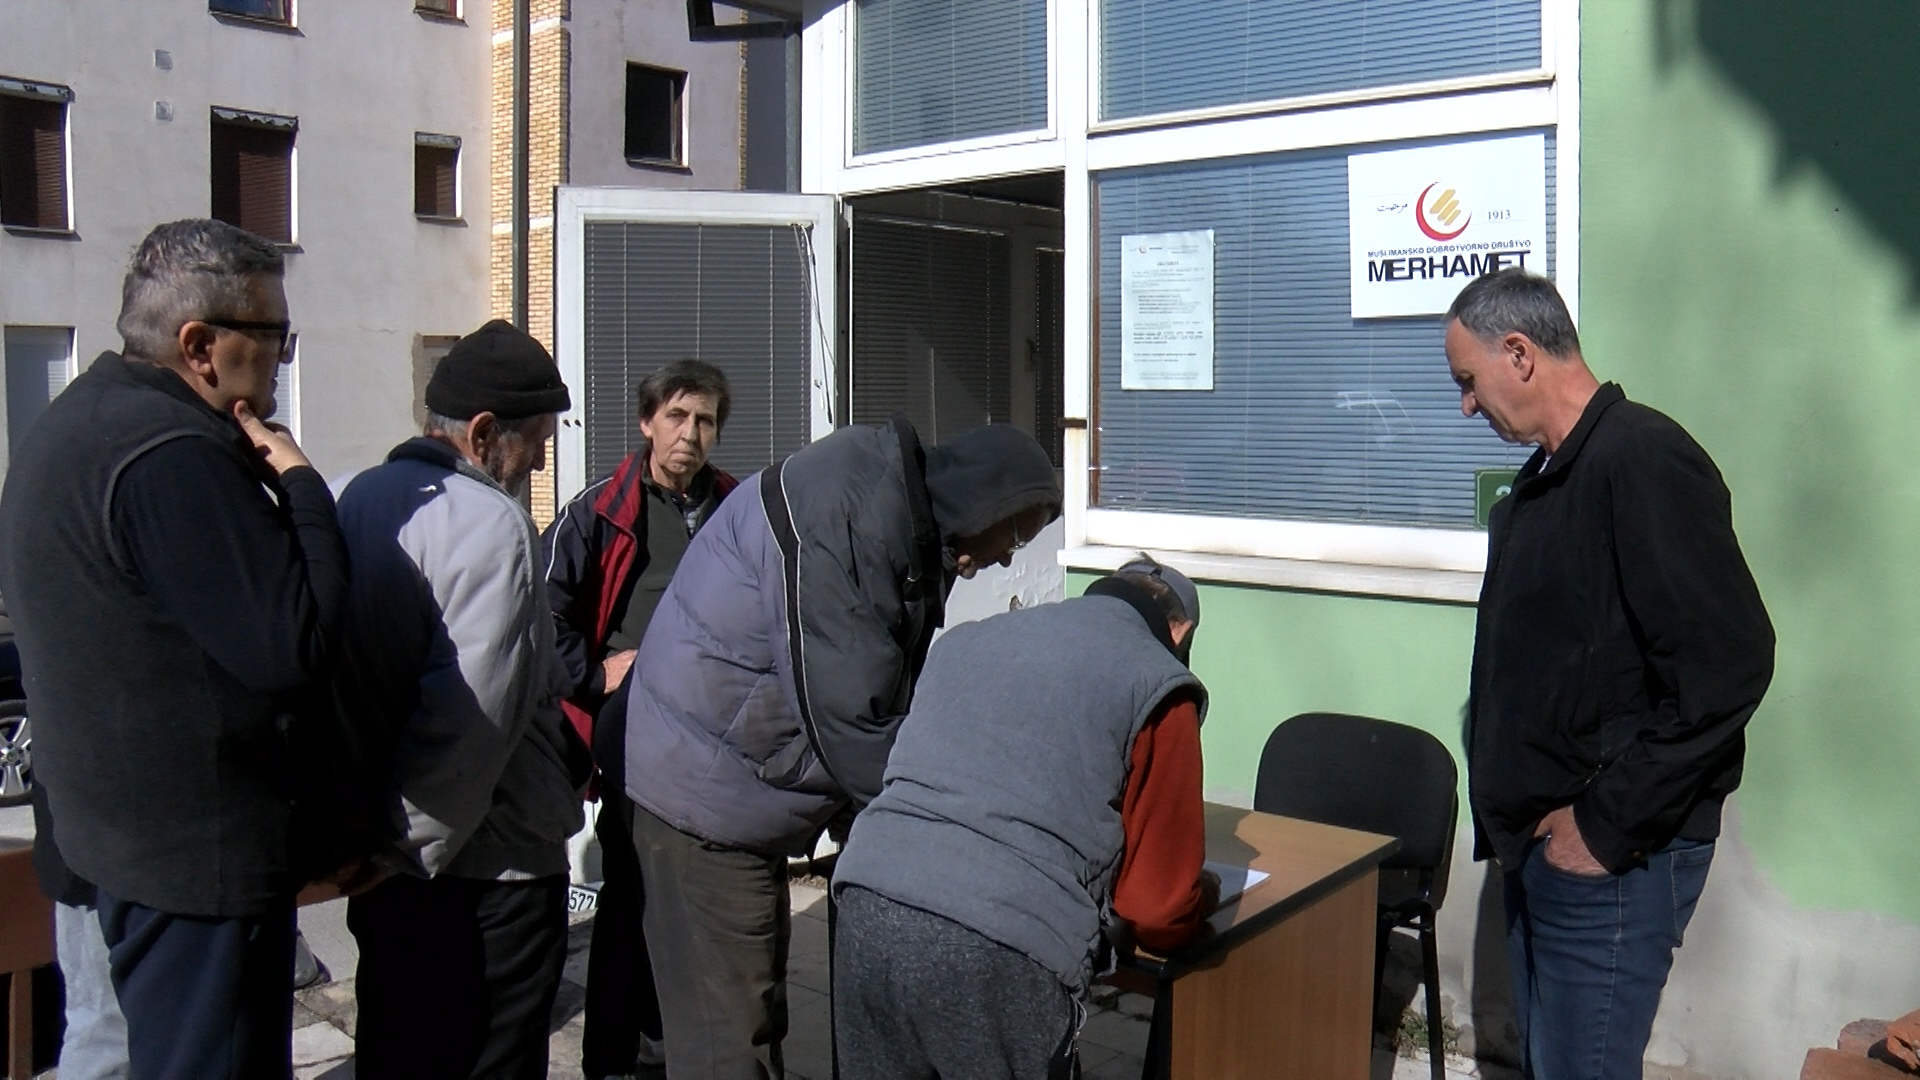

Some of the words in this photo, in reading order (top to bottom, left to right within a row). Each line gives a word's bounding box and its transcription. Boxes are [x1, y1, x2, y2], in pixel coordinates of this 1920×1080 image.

[1488, 209, 1511, 220] 1913
[1367, 247, 1425, 258] MUSLIMANSKO
[1426, 242, 1490, 254] DOBROTVORNO
[1491, 239, 1532, 250] DRUŠTVO
